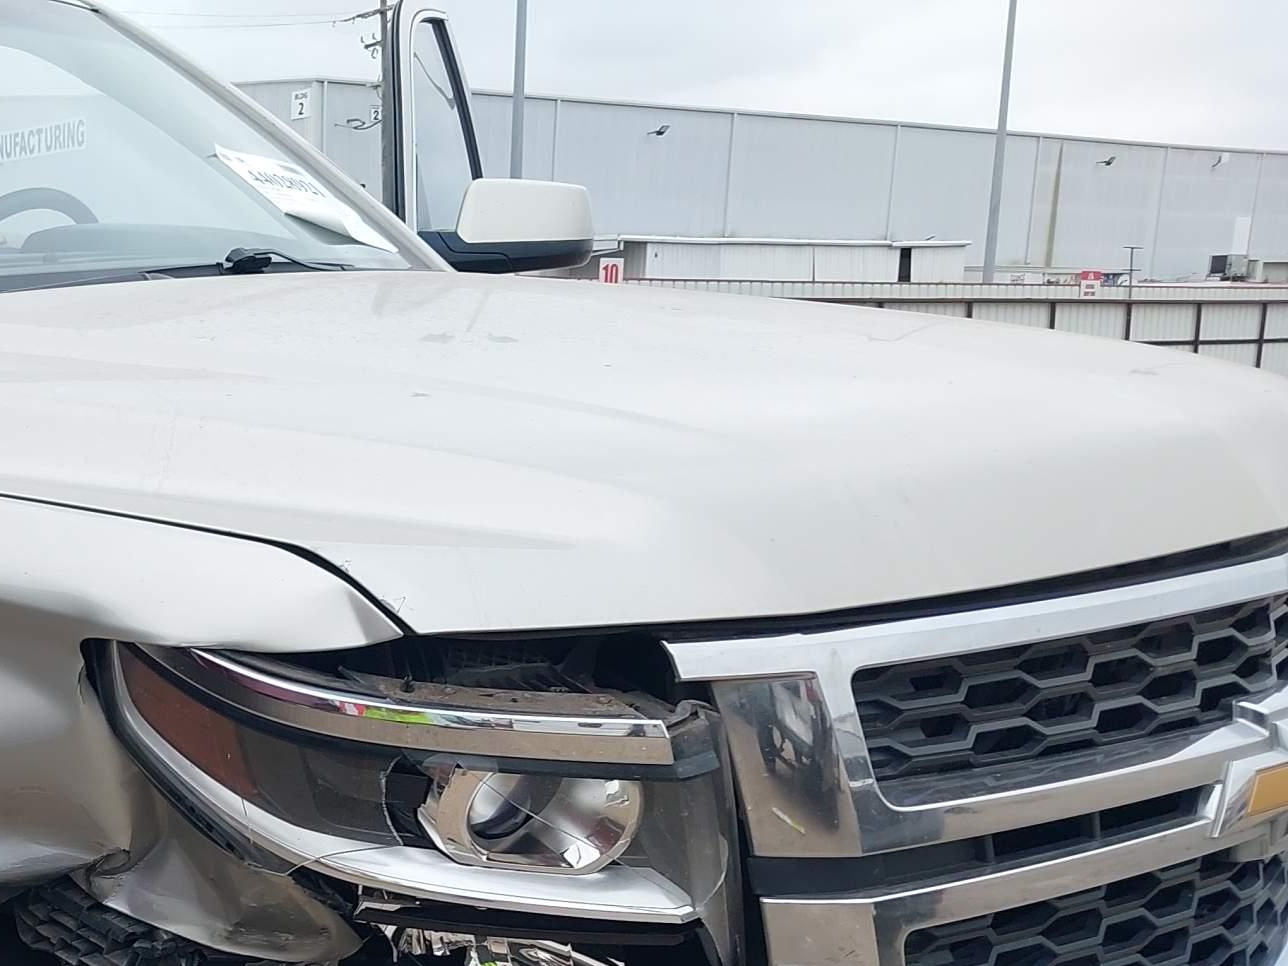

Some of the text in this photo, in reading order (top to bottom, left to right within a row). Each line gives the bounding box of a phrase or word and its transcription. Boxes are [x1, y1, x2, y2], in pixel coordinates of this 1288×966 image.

[297, 102, 305, 116] 2
[372, 110, 381, 121] 2
[602, 263, 619, 284] 10
